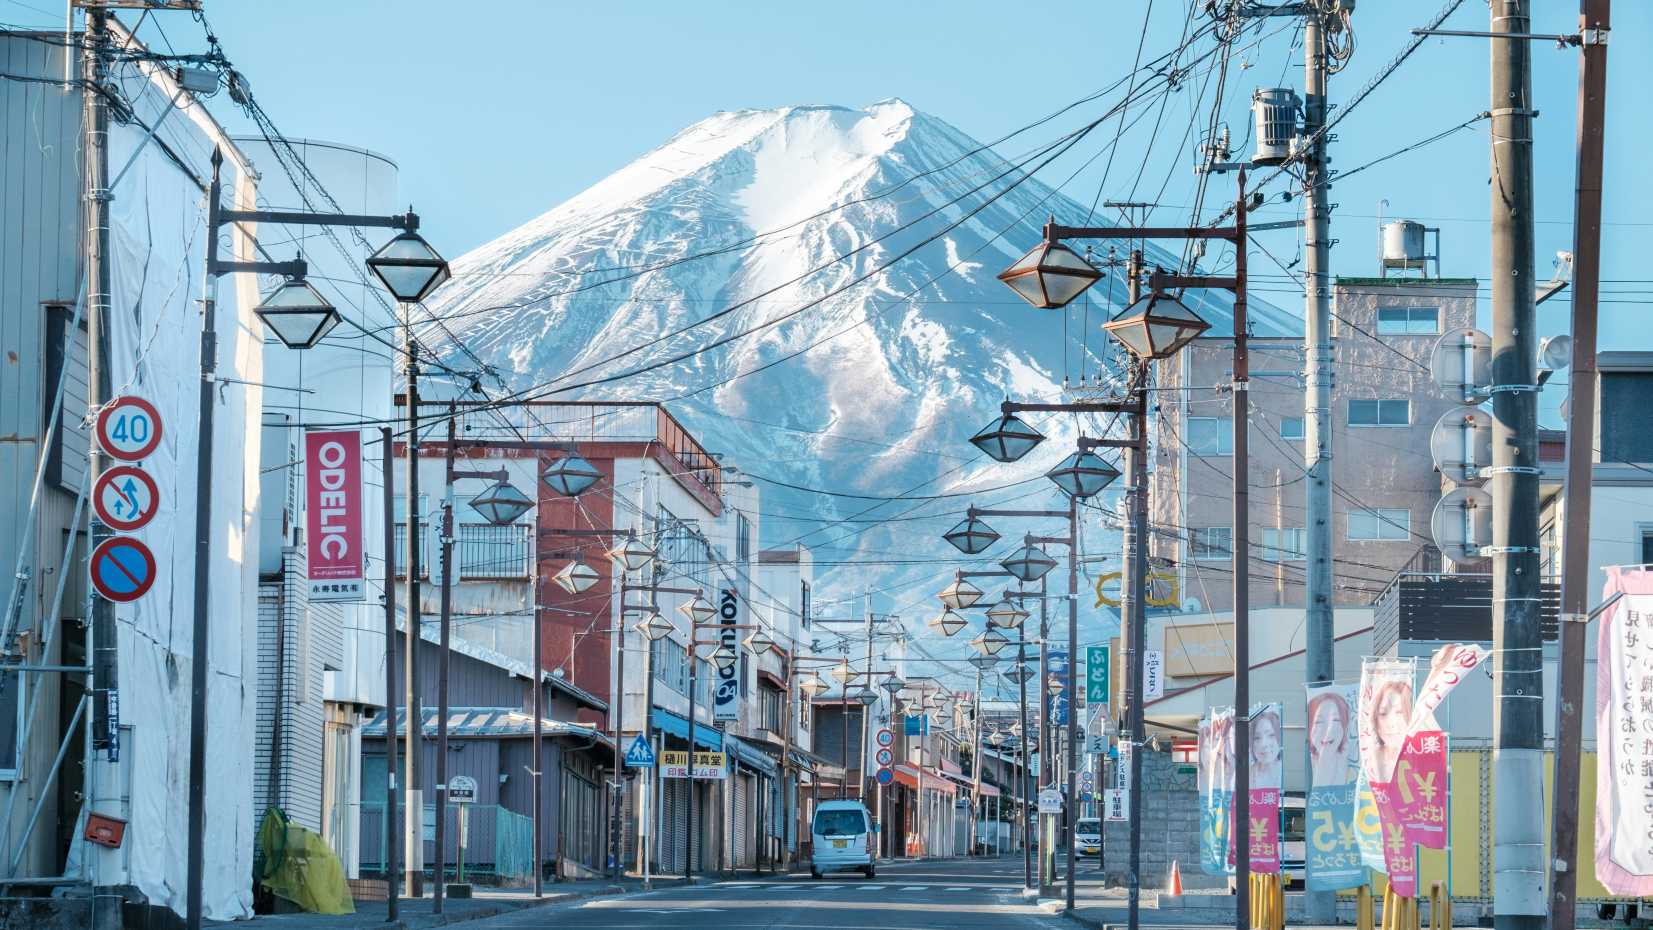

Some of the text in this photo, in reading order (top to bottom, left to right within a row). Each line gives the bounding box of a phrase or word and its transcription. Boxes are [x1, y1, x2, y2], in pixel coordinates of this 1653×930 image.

[112, 415, 147, 442] 40
[319, 441, 348, 561] ODELIC
[719, 589, 738, 680] KOKUO
[1091, 650, 1105, 699] ふとん
